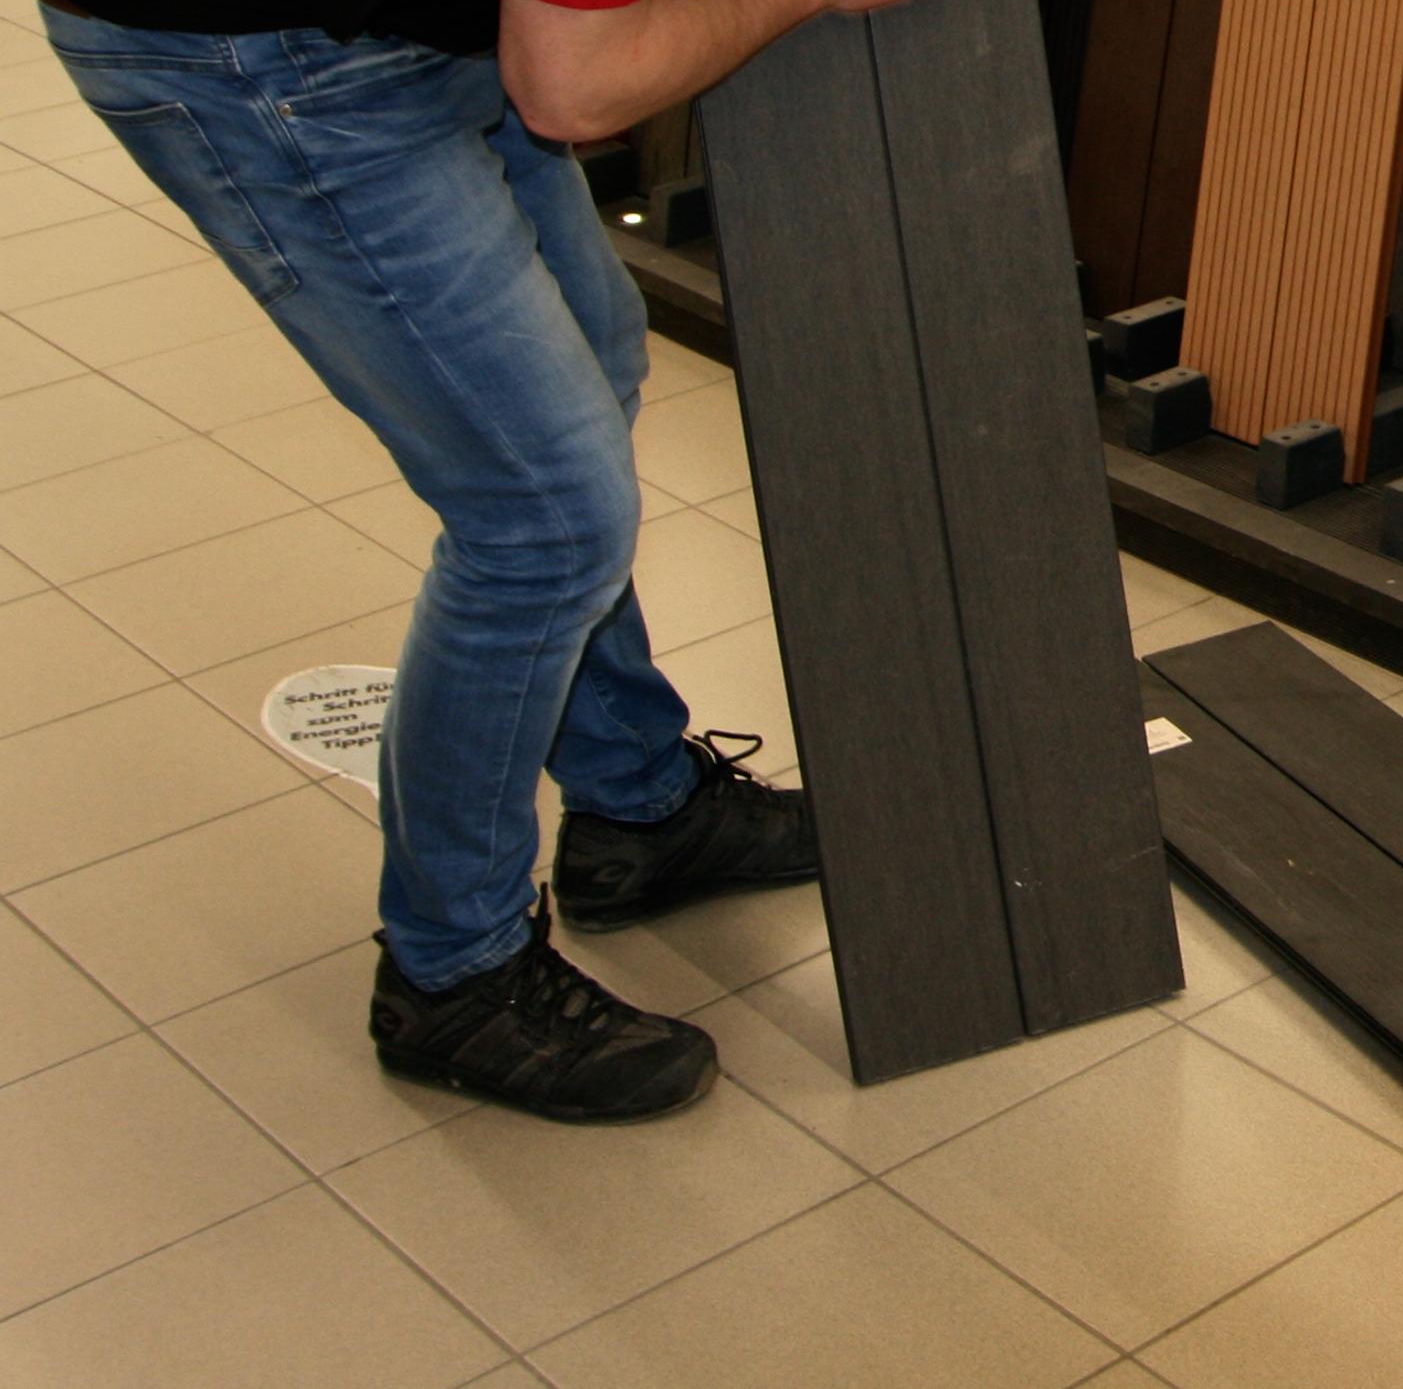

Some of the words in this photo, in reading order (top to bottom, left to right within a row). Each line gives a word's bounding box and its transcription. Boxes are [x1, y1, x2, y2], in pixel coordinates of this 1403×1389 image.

[285, 688, 357, 705] Schritt
[323, 695, 391, 711] Schrit
[307, 713, 358, 727] zum
